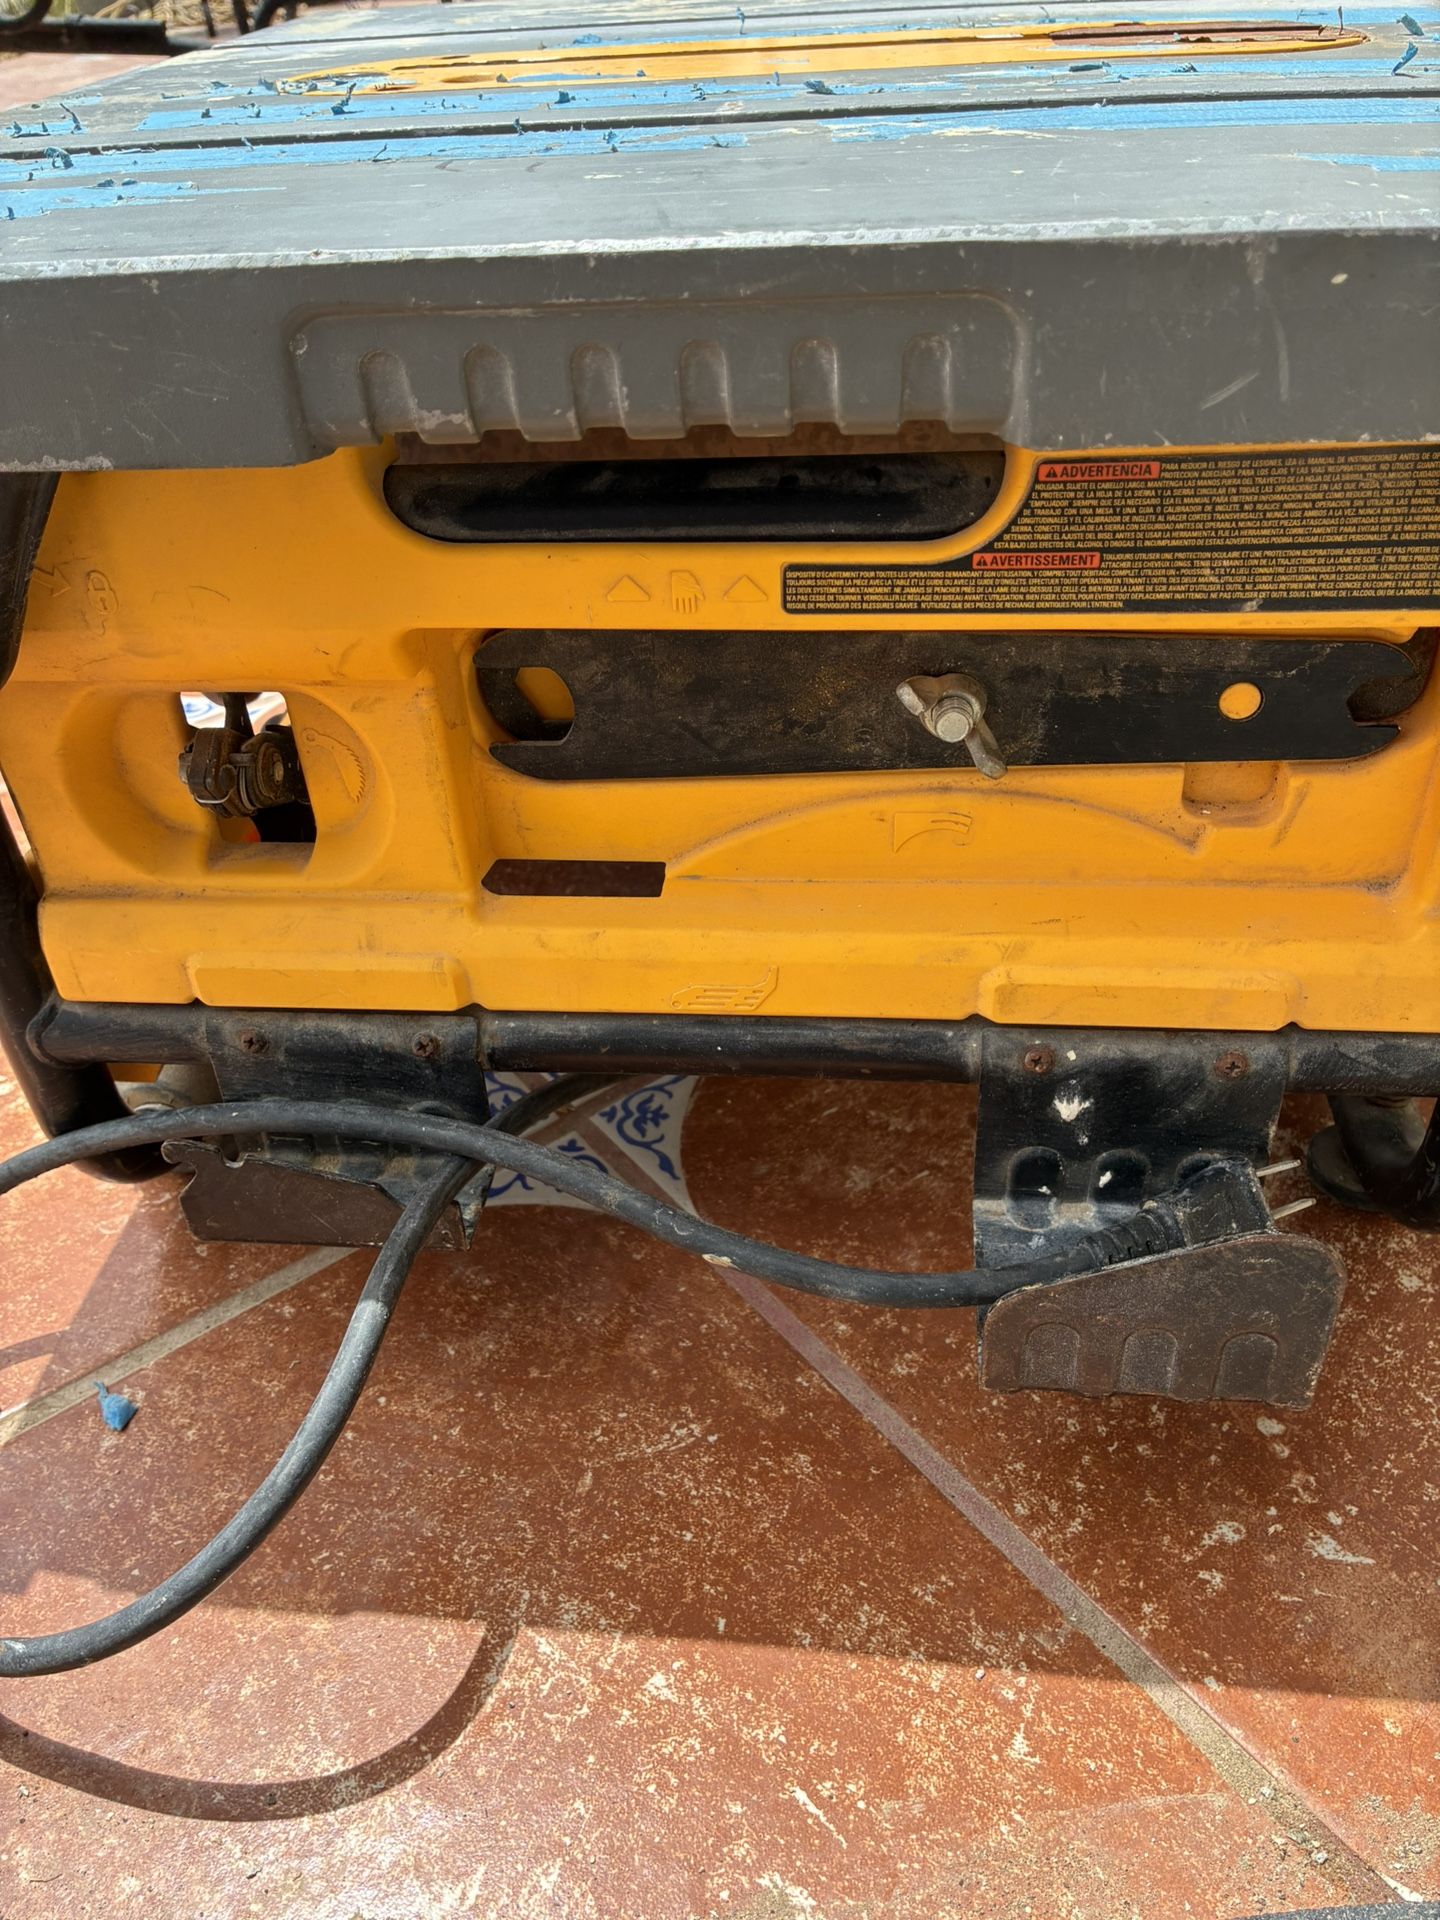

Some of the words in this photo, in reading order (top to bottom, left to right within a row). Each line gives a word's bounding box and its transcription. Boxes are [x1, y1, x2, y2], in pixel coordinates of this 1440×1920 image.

[1060, 464, 1152, 478] ADVERTENCIA
[1270, 467, 1288, 475] OJOS
[1197, 478, 1220, 486] MANOS
[1040, 491, 1074, 499] PROTECTOR
[1083, 515, 1121, 523] CALIBRADOR
[1187, 513, 1211, 521] CORTES
[1174, 551, 1211, 559] PROTECTION
[990, 554, 1096, 567] AVERTISSEMENT
